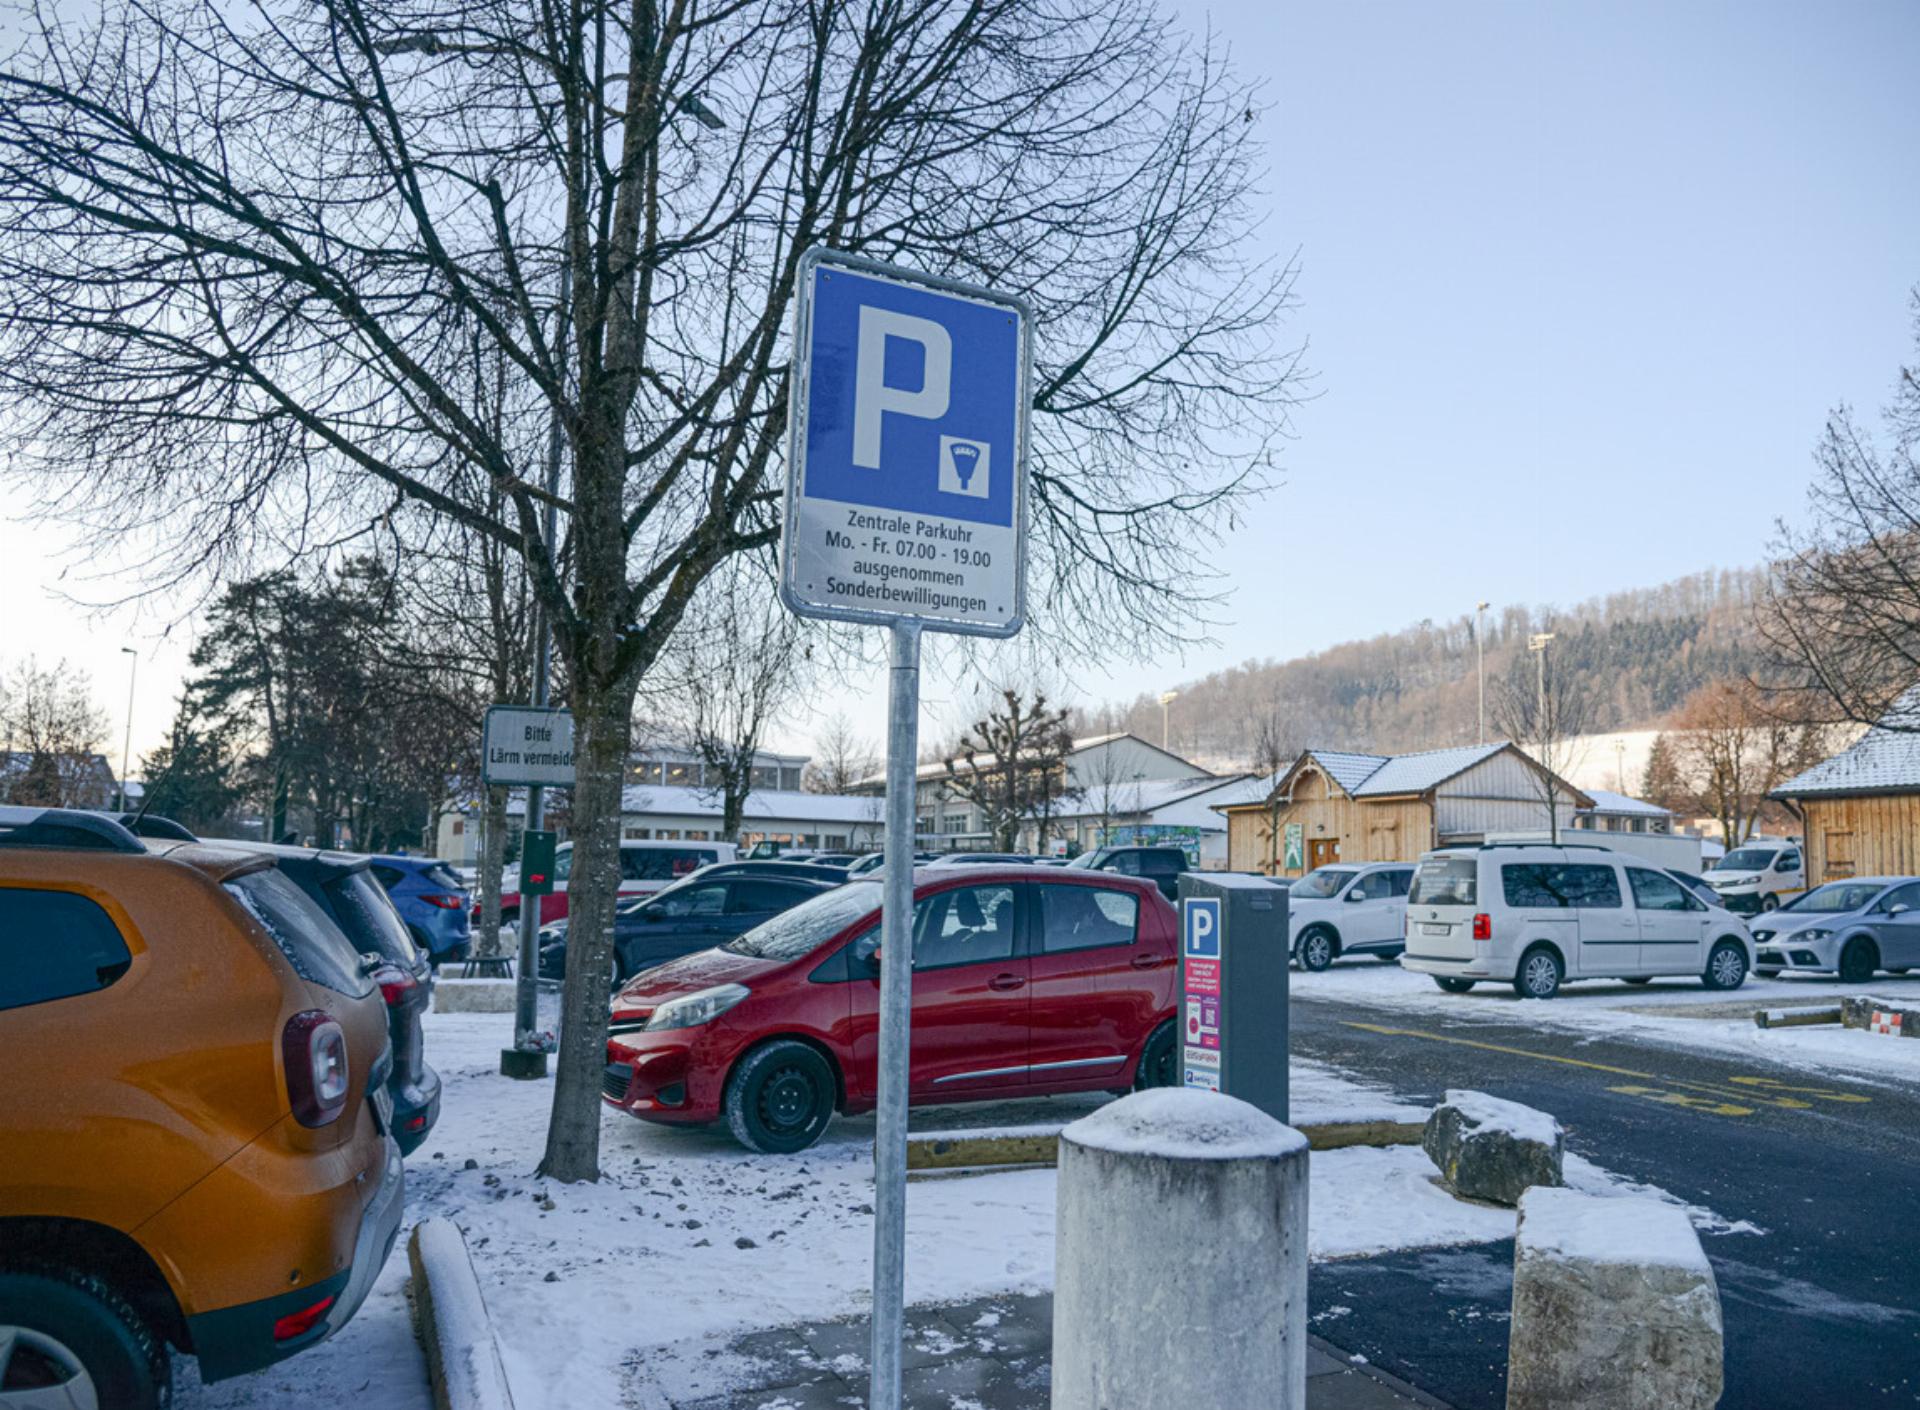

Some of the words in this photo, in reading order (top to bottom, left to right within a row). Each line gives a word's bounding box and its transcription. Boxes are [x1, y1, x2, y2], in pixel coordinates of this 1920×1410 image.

[853, 305, 952, 469] P
[848, 510, 911, 535] Zentrale
[916, 520, 973, 543] Parkuhr
[825, 530, 855, 550] Mo.
[872, 536, 890, 554] Fr.
[896, 540, 936, 560] 07.00
[953, 548, 991, 568] 19.00
[853, 559, 964, 586] ausgenommen
[827, 577, 986, 613] Sonderbewilligungen
[524, 725, 552, 741] Bitte
[490, 747, 520, 764] Lärm
[523, 750, 575, 766] vermeide
[1192, 908, 1214, 950] P
